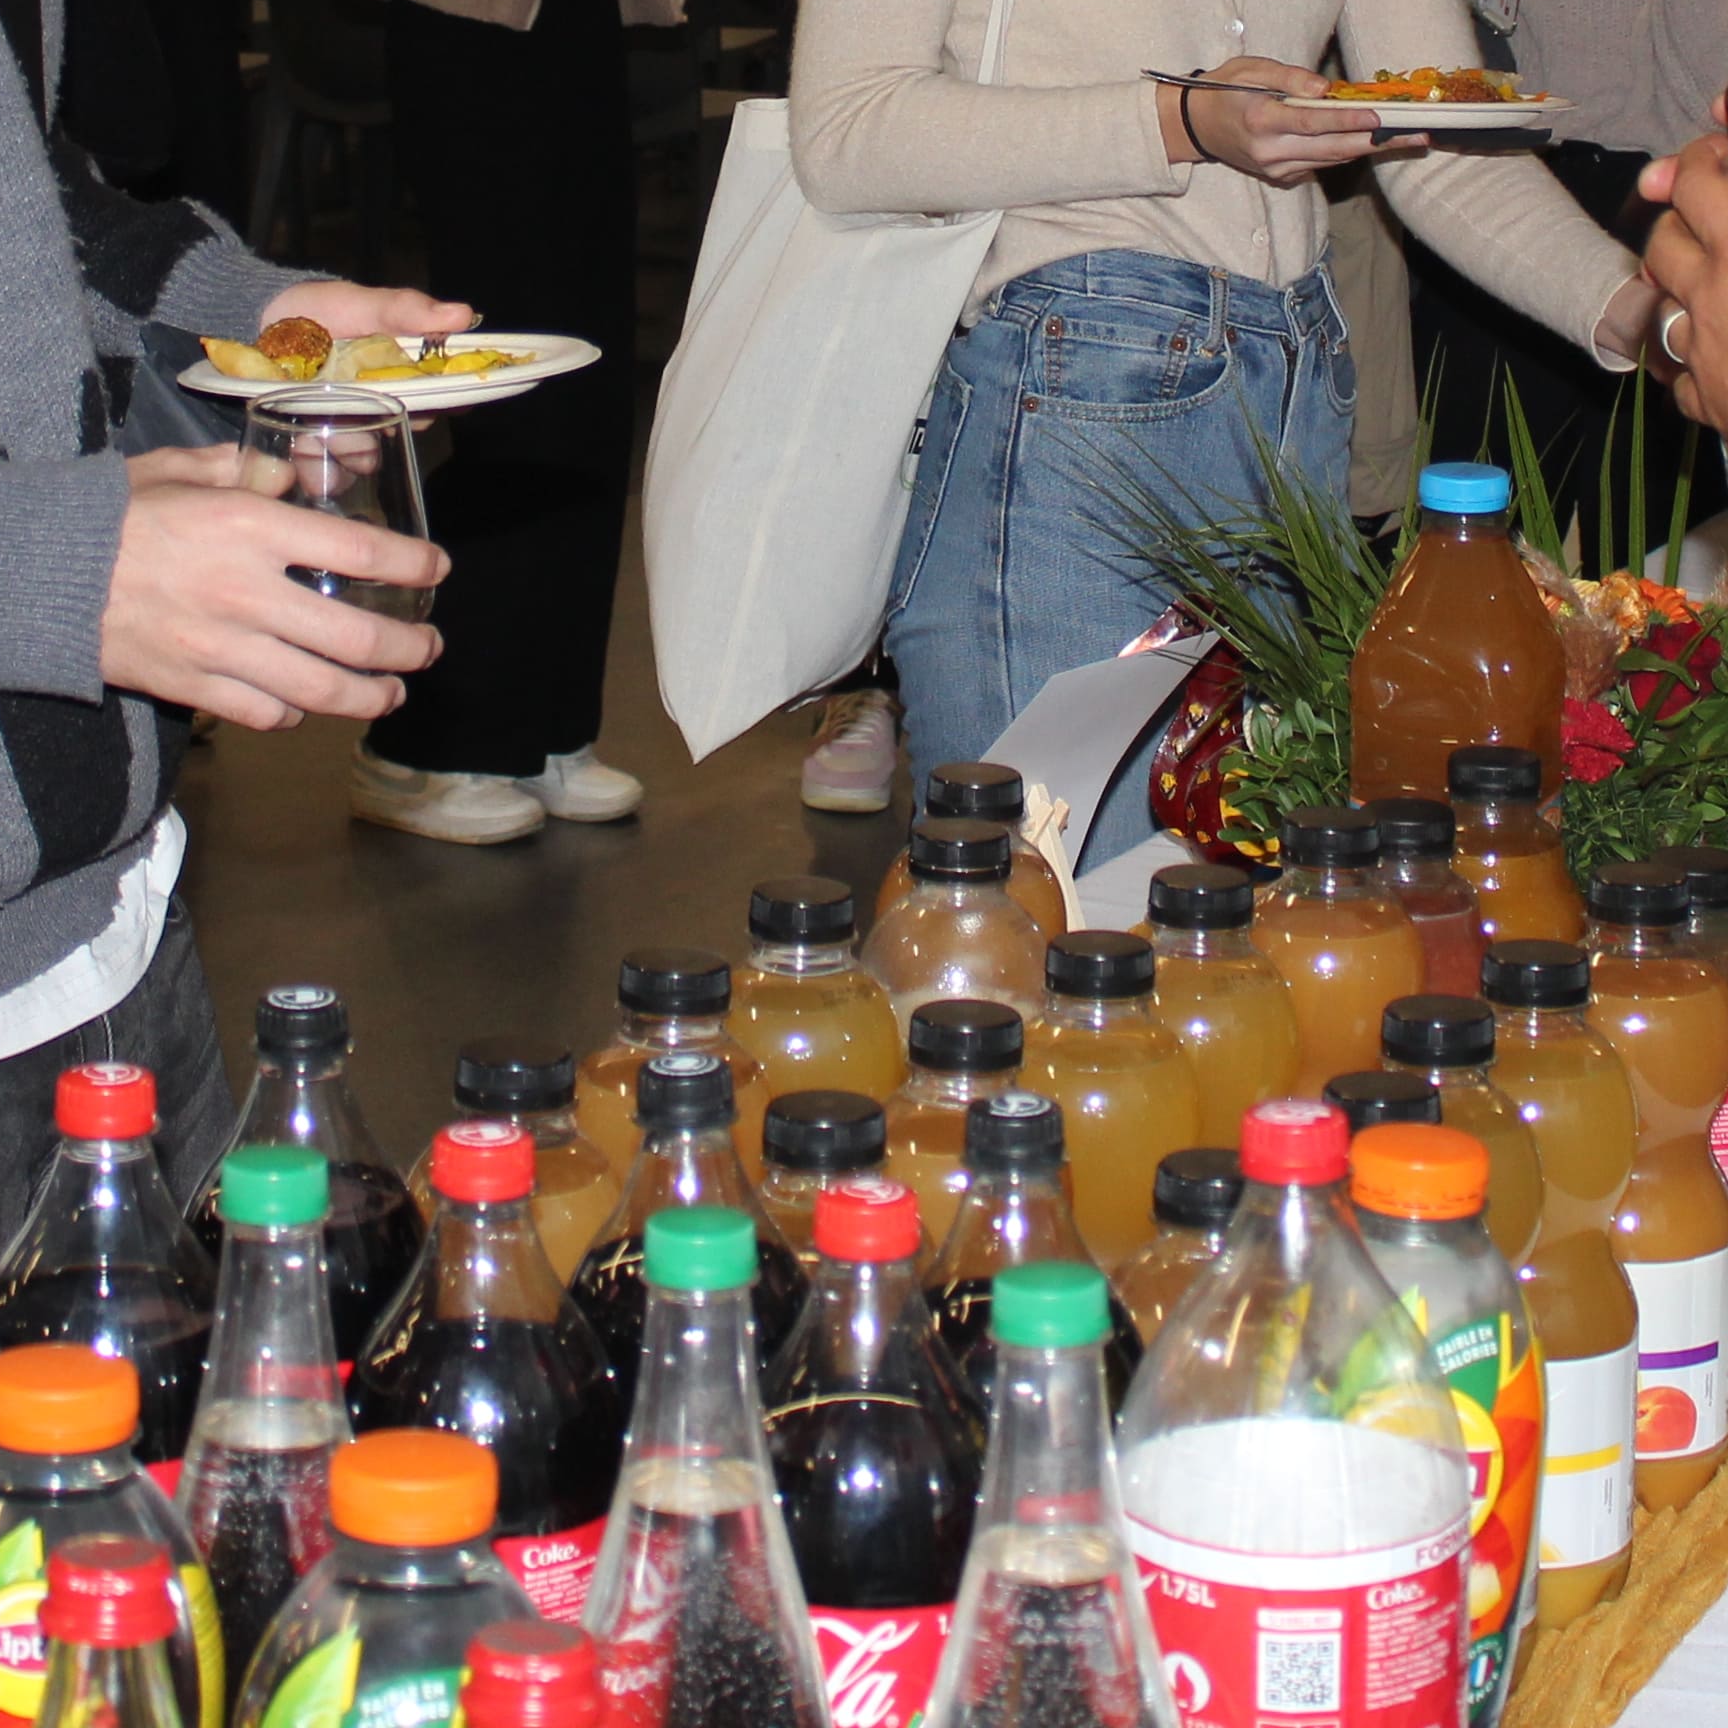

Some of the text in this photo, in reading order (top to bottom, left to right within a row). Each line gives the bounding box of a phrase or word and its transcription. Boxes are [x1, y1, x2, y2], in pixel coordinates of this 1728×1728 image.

[1435, 1329, 1477, 1360] FAIBLE
[1439, 1341, 1498, 1374] CALORIES
[1159, 1573, 1217, 1610] 1.75L
